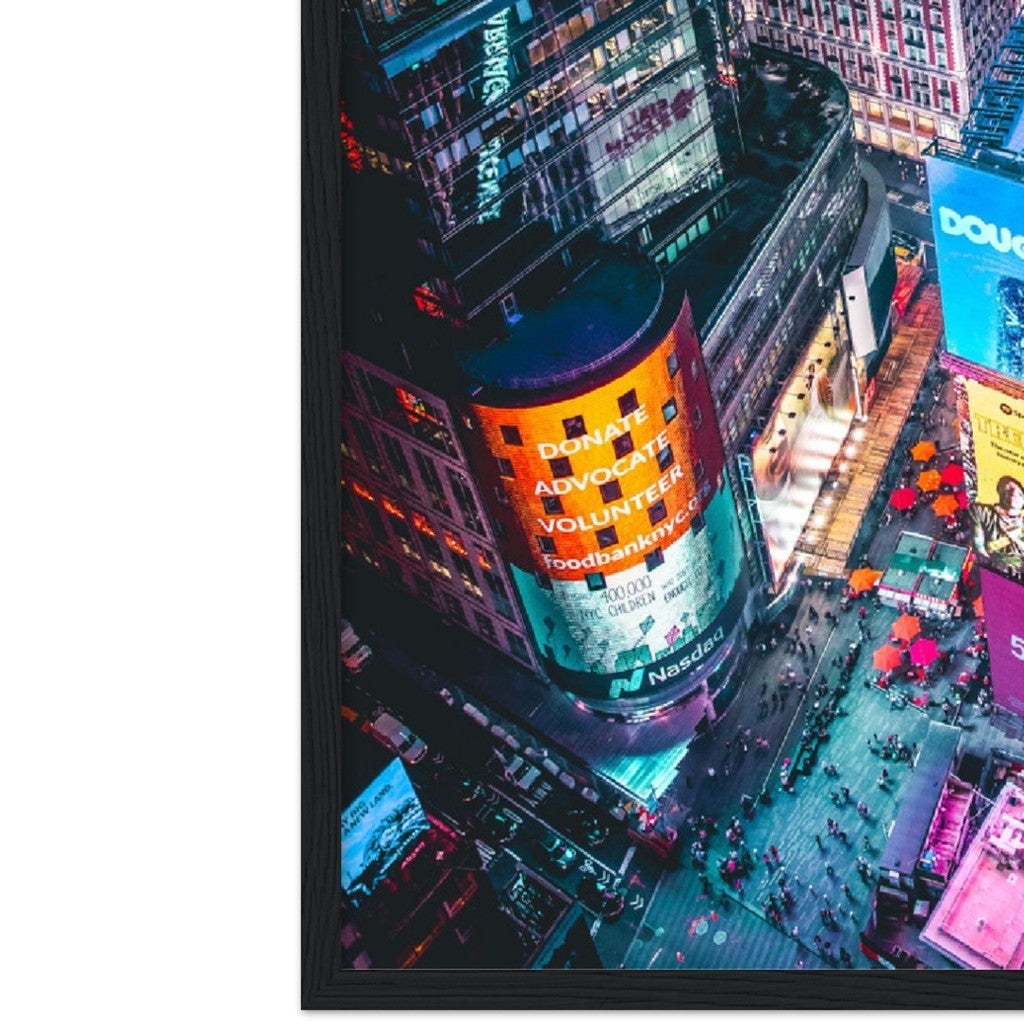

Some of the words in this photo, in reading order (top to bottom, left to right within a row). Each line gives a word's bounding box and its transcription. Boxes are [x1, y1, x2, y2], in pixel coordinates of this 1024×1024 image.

[537, 403, 650, 460] DONATE
[534, 429, 671, 496] ADVOCATE
[537, 463, 684, 534] VOLUNTEER
[608, 591, 656, 618] CHILDREN
[648, 628, 725, 687] Nasdaq
